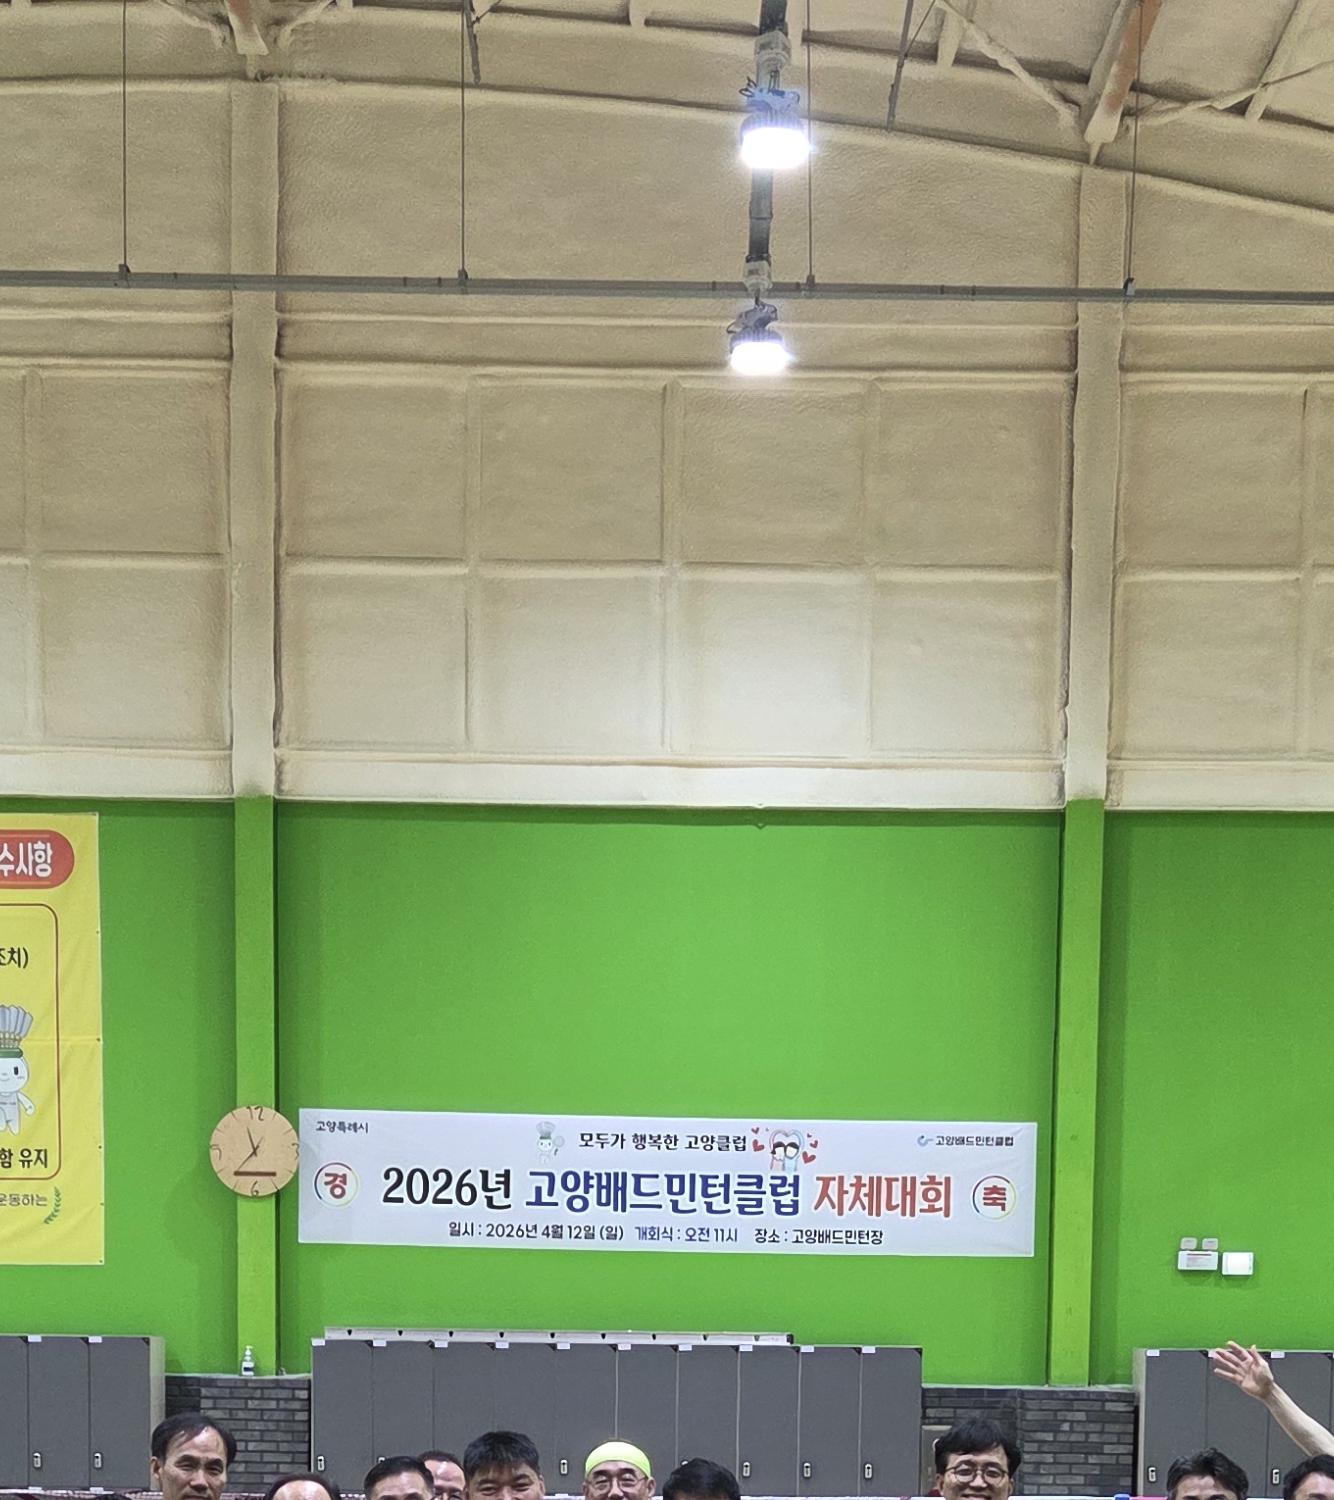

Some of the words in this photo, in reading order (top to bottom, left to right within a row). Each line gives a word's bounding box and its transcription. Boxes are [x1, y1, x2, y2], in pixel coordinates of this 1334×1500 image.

[246, 1106, 265, 1121] 12
[316, 1121, 368, 1133] 고양특례시
[579, 1133, 626, 1149] 모두가
[632, 1133, 679, 1150] 행복한
[685, 1135, 746, 1151] 고양클럽
[936, 1136, 1013, 1146] 고양배드민턴클럽
[19, 1148, 47, 1168] 유지
[324, 1173, 347, 1199] 경
[383, 1168, 511, 1210] 2026년
[526, 1171, 799, 1216] 고양배드민턴클럽
[814, 1175, 950, 1218] 자체대회
[983, 1185, 1006, 1211] 축
[449, 1222, 473, 1236] 일시
[486, 1224, 537, 1238] 2026년
[542, 1225, 563, 1239] 4월
[568, 1226, 595, 1239] 12일
[600, 1226, 623, 1240] (일)
[635, 1226, 672, 1241] 개회식
[685, 1228, 709, 1242] 오전
[714, 1229, 737, 1242] 11시
[755, 1229, 780, 1243] 장소
[792, 1230, 883, 1245] 고양배드민턴장
